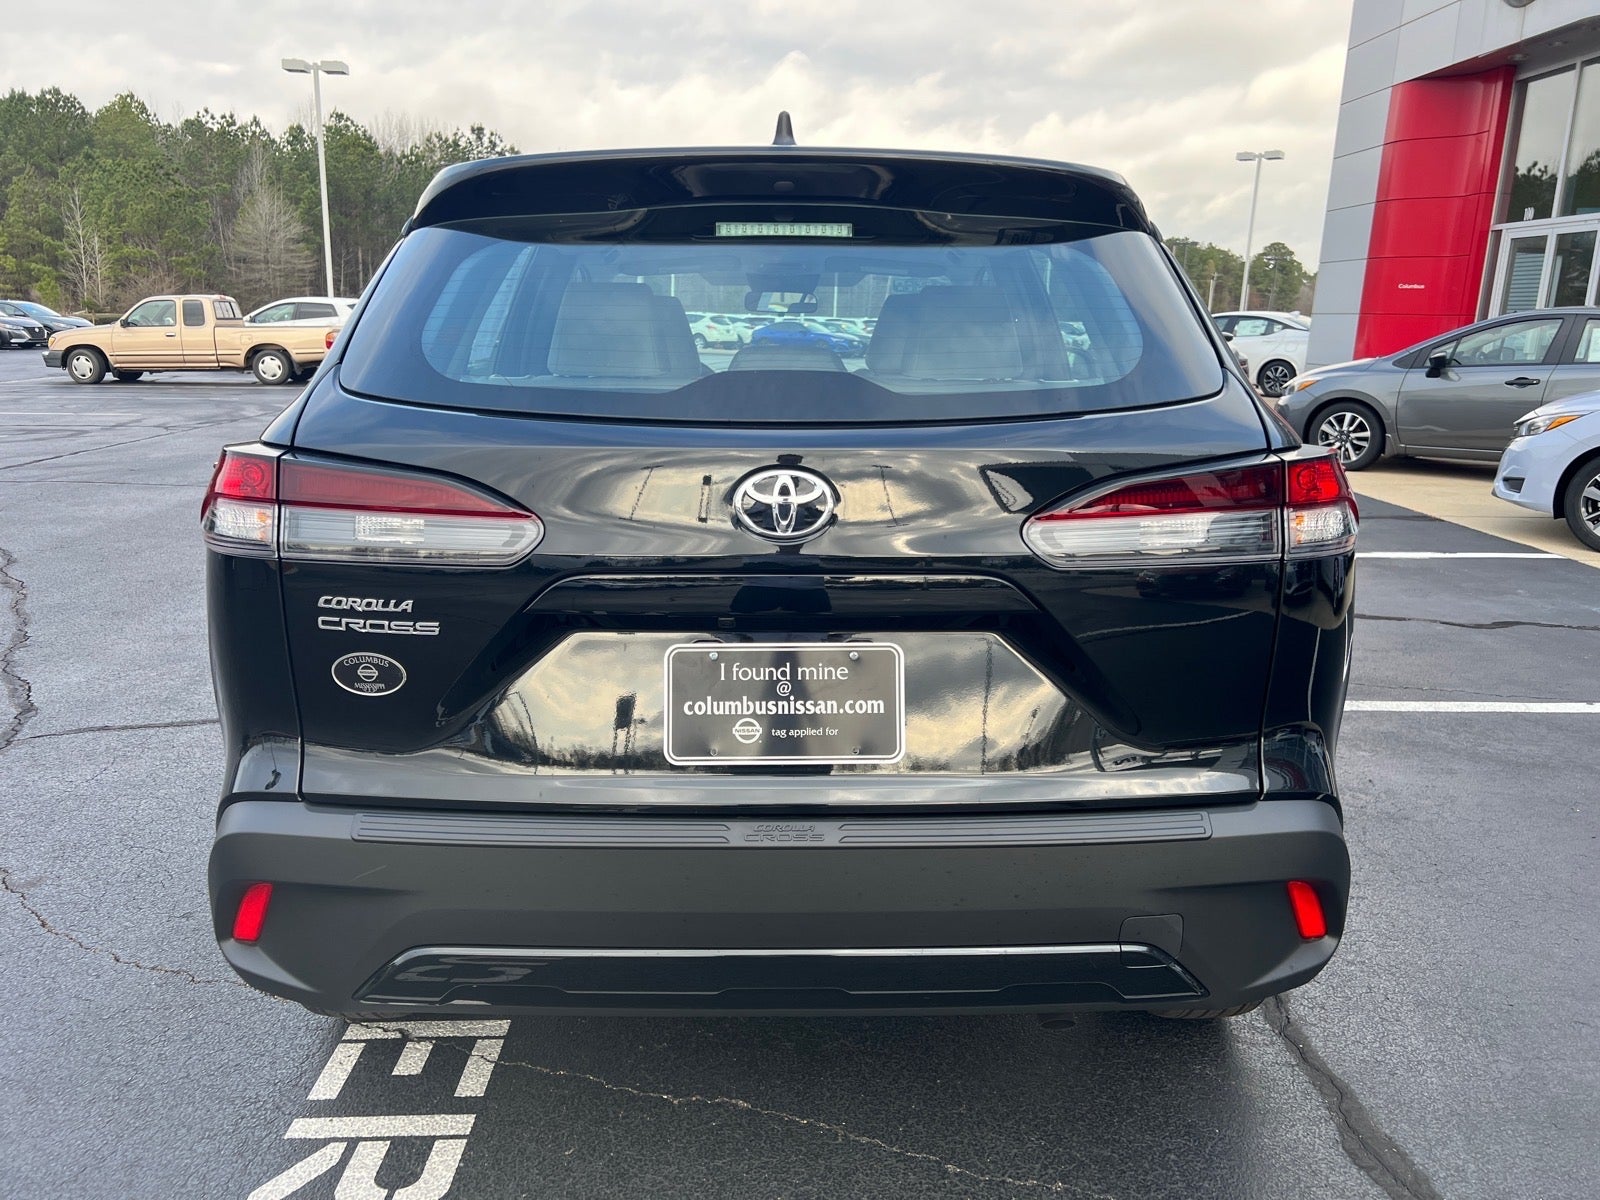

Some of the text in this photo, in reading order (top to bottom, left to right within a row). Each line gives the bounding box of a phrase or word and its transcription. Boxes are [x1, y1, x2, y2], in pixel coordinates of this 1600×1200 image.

[317, 595, 414, 613] COROLLA
[317, 616, 440, 636] CROSS
[343, 656, 389, 668] COLUMBUS
[720, 662, 849, 681] I found mine
[776, 681, 792, 697] @
[683, 695, 885, 715] columbusnissan.com
[771, 727, 839, 738] tag applied for
[754, 824, 816, 832] COROLLA
[744, 833, 825, 842] CROSS
